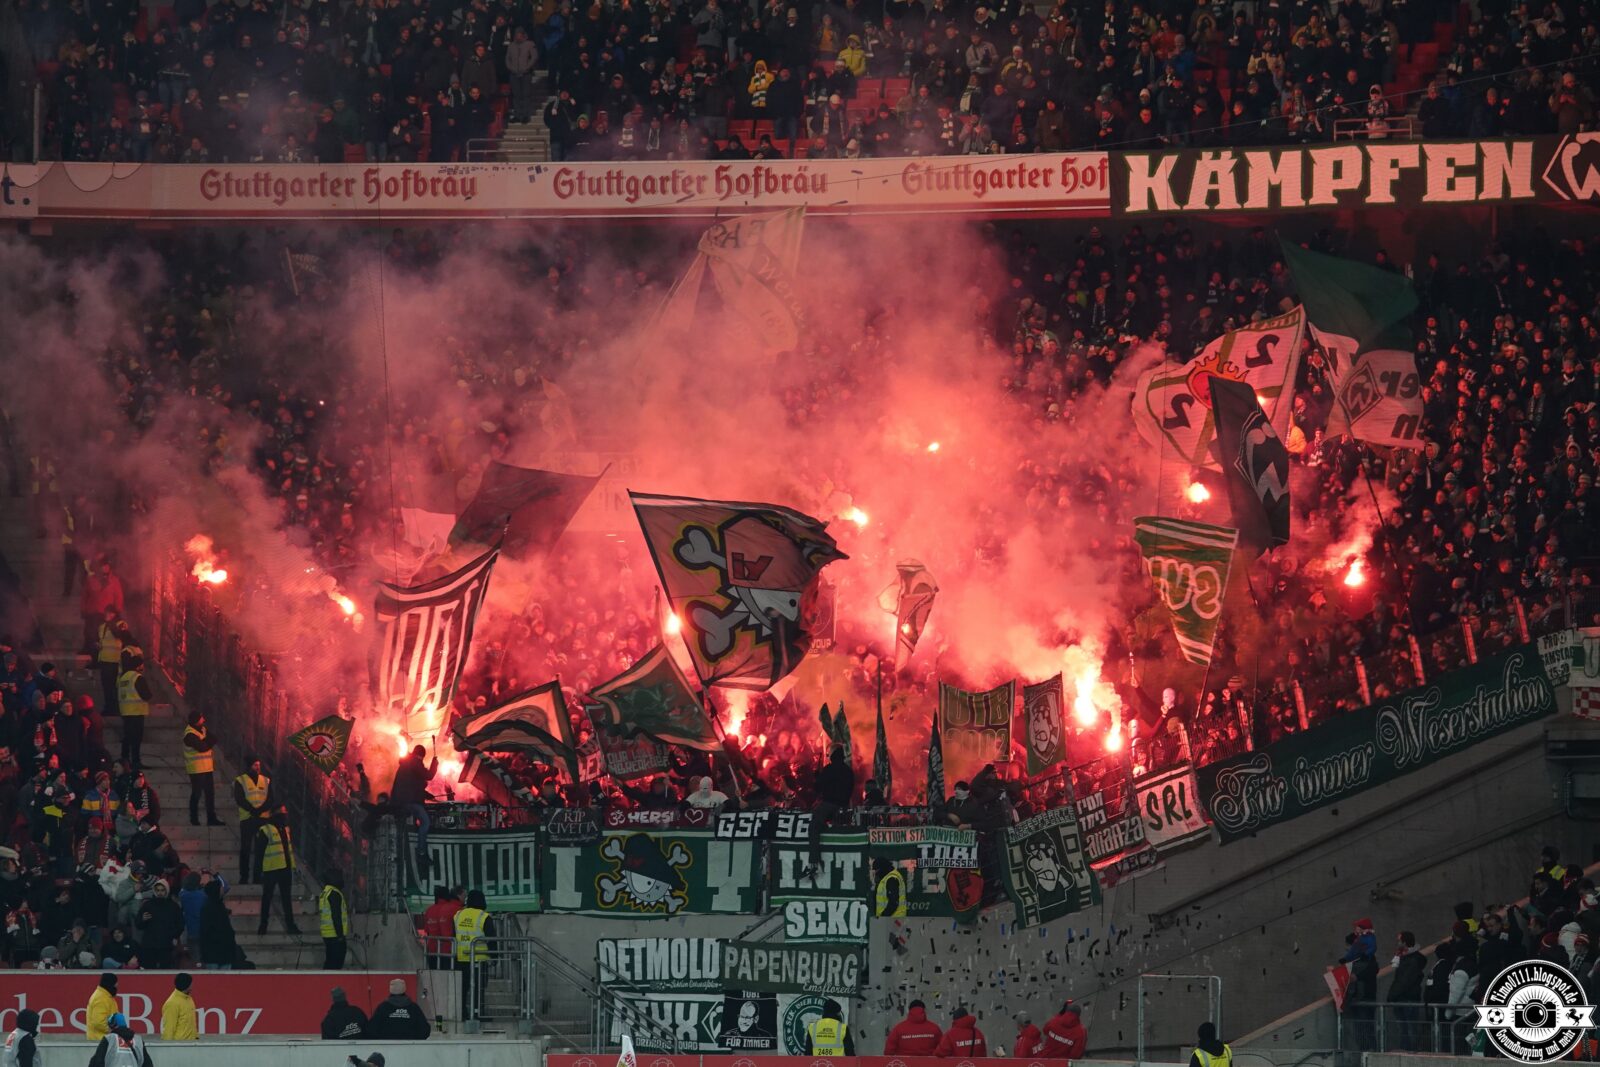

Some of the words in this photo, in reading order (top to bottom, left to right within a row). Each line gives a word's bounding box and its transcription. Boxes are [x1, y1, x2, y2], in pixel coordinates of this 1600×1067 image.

[200, 168, 356, 207] Stuttgarter
[362, 168, 478, 204] Hofbräu
[552, 166, 708, 203] Stuttgarter
[714, 165, 829, 200] Hofbräu
[902, 161, 1054, 199] Stuttgarter
[1124, 141, 1535, 213] KÄMPFEN
[1210, 752, 1287, 831] Für
[1295, 740, 1375, 807] immer
[1376, 652, 1552, 768] Weserstadion
[785, 901, 868, 937] SEKO
[598, 938, 720, 982] DETMOLD
[724, 946, 858, 988] PAPENBURG
[116, 993, 264, 1034] Bnz
[725, 1037, 741, 1048] FÜR
[743, 1039, 770, 1049] IMMER
